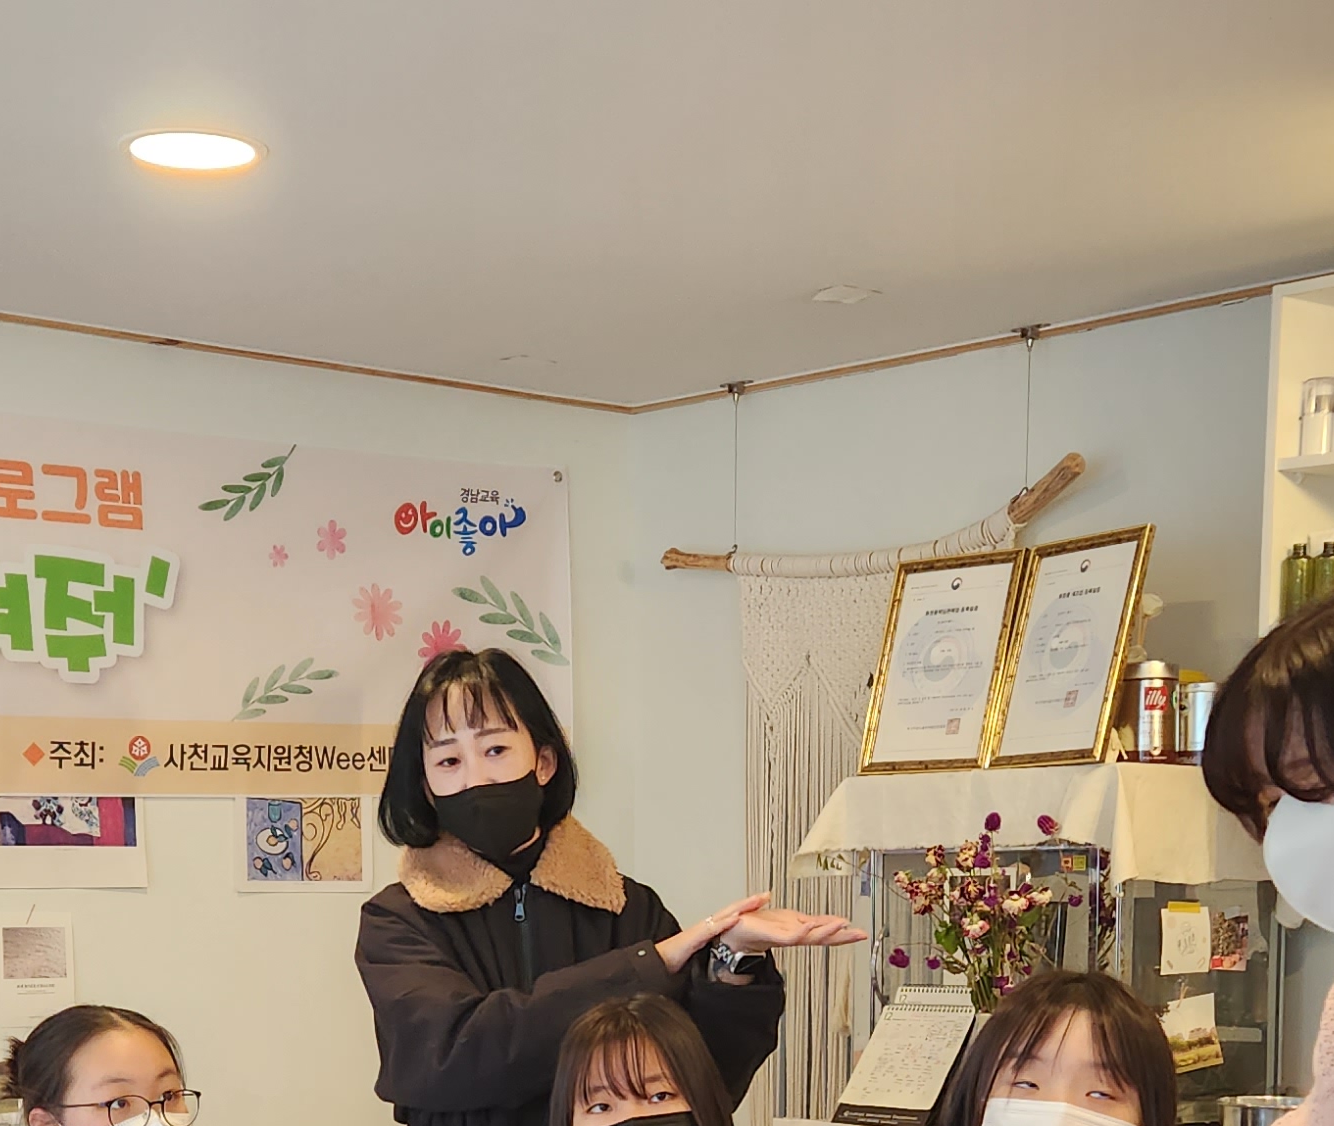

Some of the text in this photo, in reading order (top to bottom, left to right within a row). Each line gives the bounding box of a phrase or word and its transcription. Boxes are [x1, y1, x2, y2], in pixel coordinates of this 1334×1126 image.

[459, 487, 501, 505] 경남교육
[394, 500, 527, 556] 아이좋아
[1145, 689, 1167, 711] illy
[48, 739, 105, 771] 주최:
